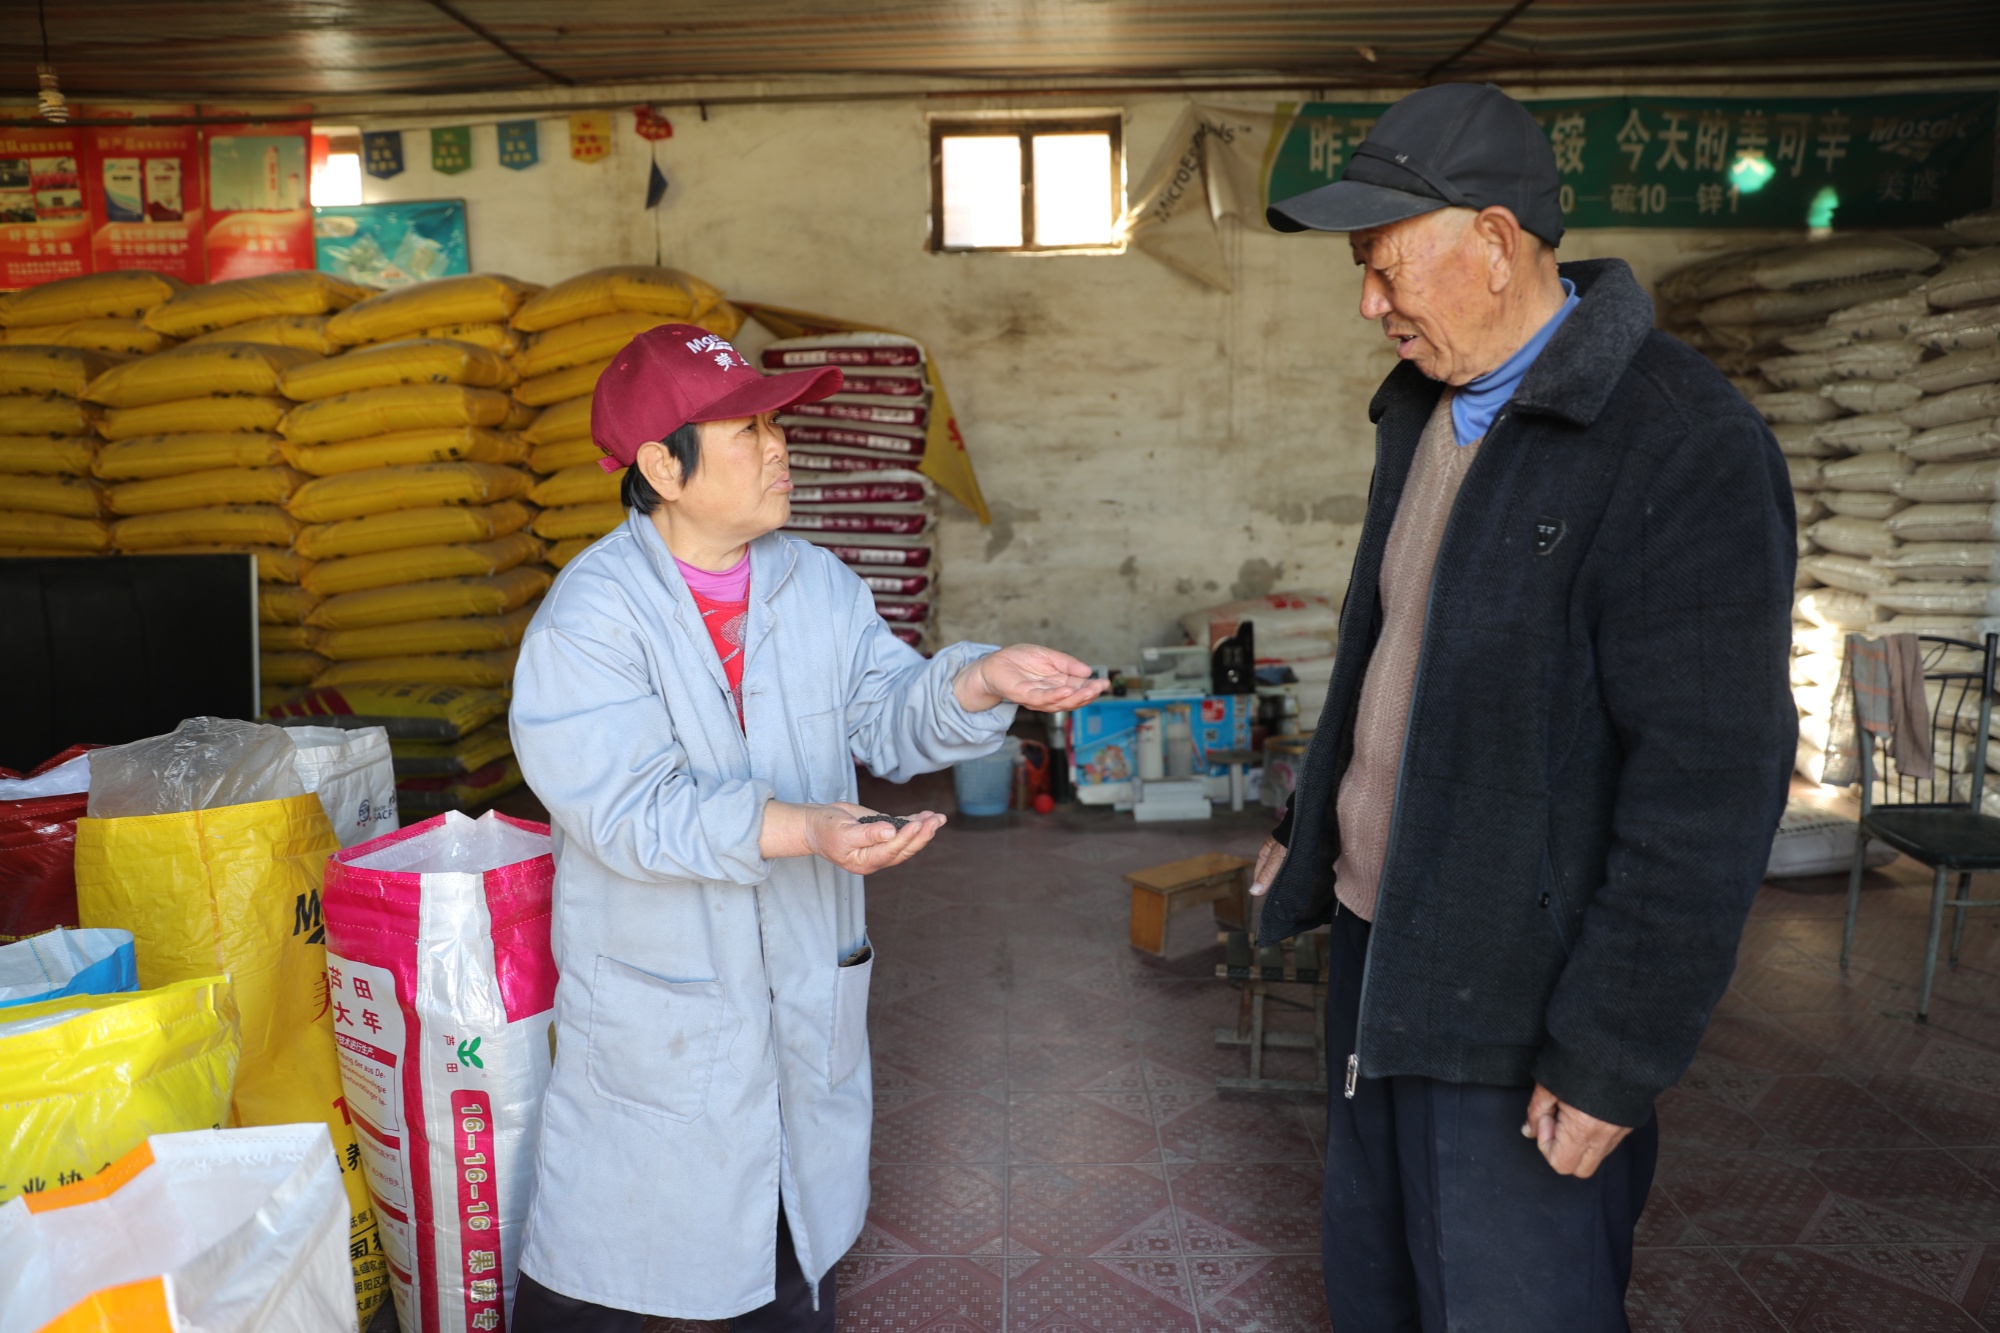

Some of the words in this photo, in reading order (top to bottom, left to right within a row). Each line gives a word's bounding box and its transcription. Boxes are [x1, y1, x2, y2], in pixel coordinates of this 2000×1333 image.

[1616, 108, 1852, 176] 今天的美可辛
[328, 965, 374, 1002] 芦田
[333, 1000, 383, 1034] 大年
[364, 1064, 374, 1075] aus
[460, 1103, 492, 1233] 16-16-16
